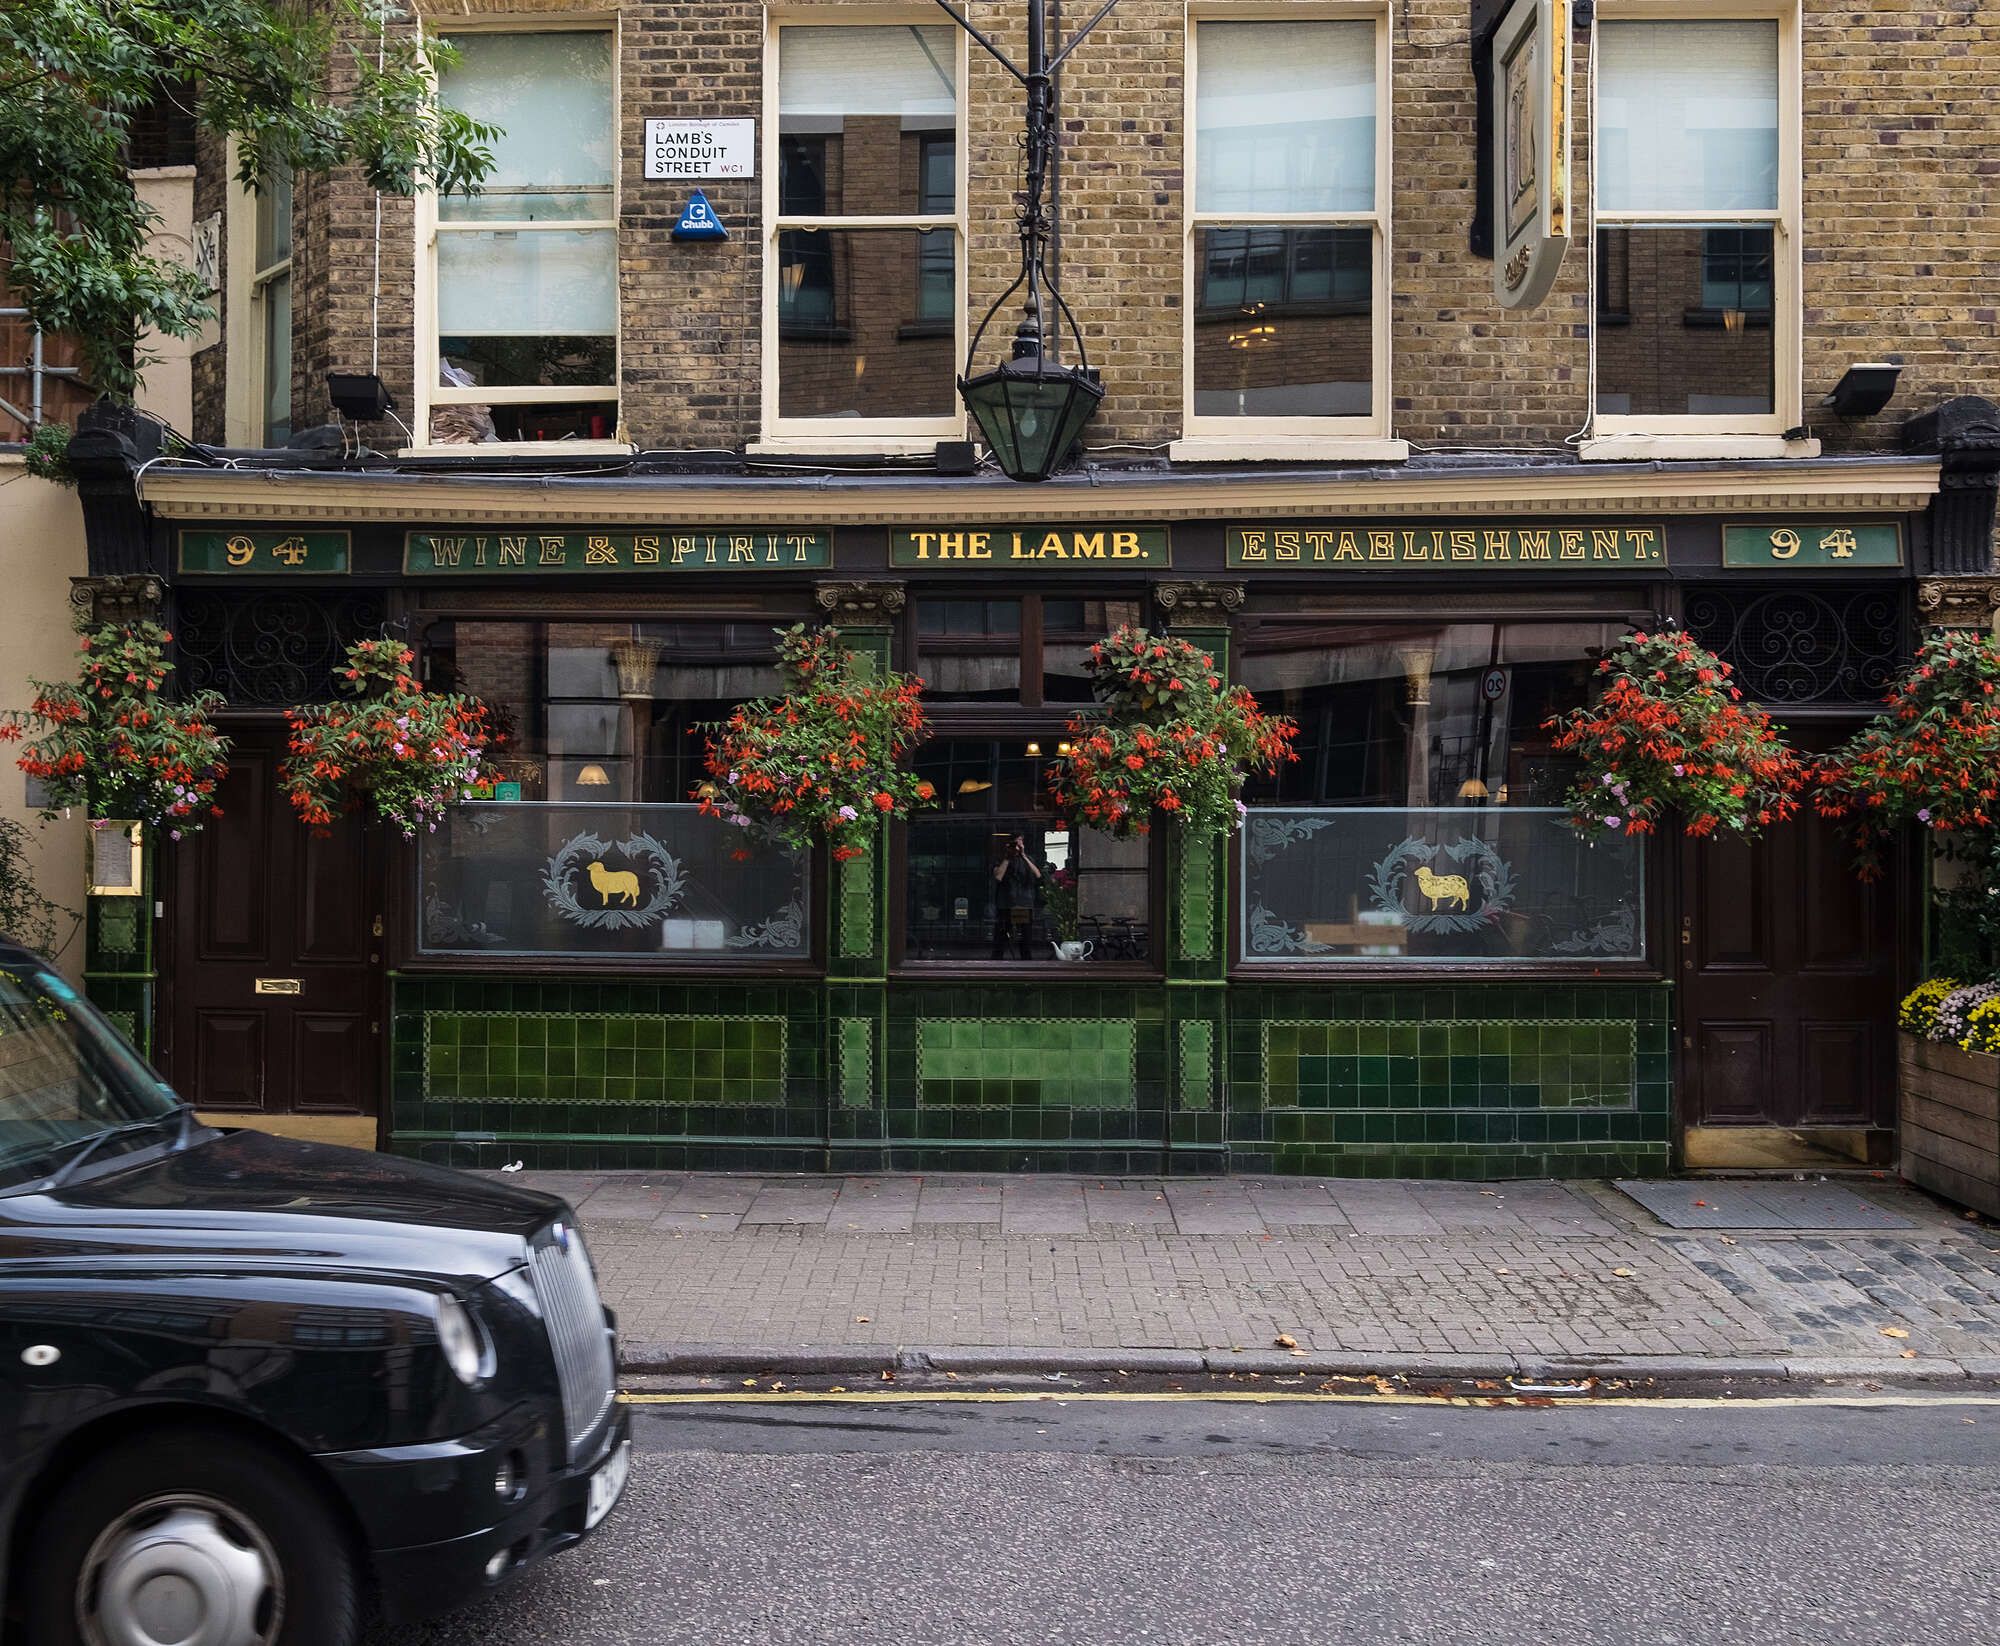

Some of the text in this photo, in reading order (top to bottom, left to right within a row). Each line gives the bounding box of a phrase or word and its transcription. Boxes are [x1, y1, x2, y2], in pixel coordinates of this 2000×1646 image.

[655, 131, 713, 145] LAMB'S
[655, 147, 727, 159] CONDUIT
[655, 162, 743, 173] STREET WC1
[681, 220, 714, 229] Chubb
[430, 534, 816, 566] WINE & SPIRIT
[910, 532, 1149, 559] THE LAMB.
[1240, 530, 1660, 561] ESTABLISHMENT.
